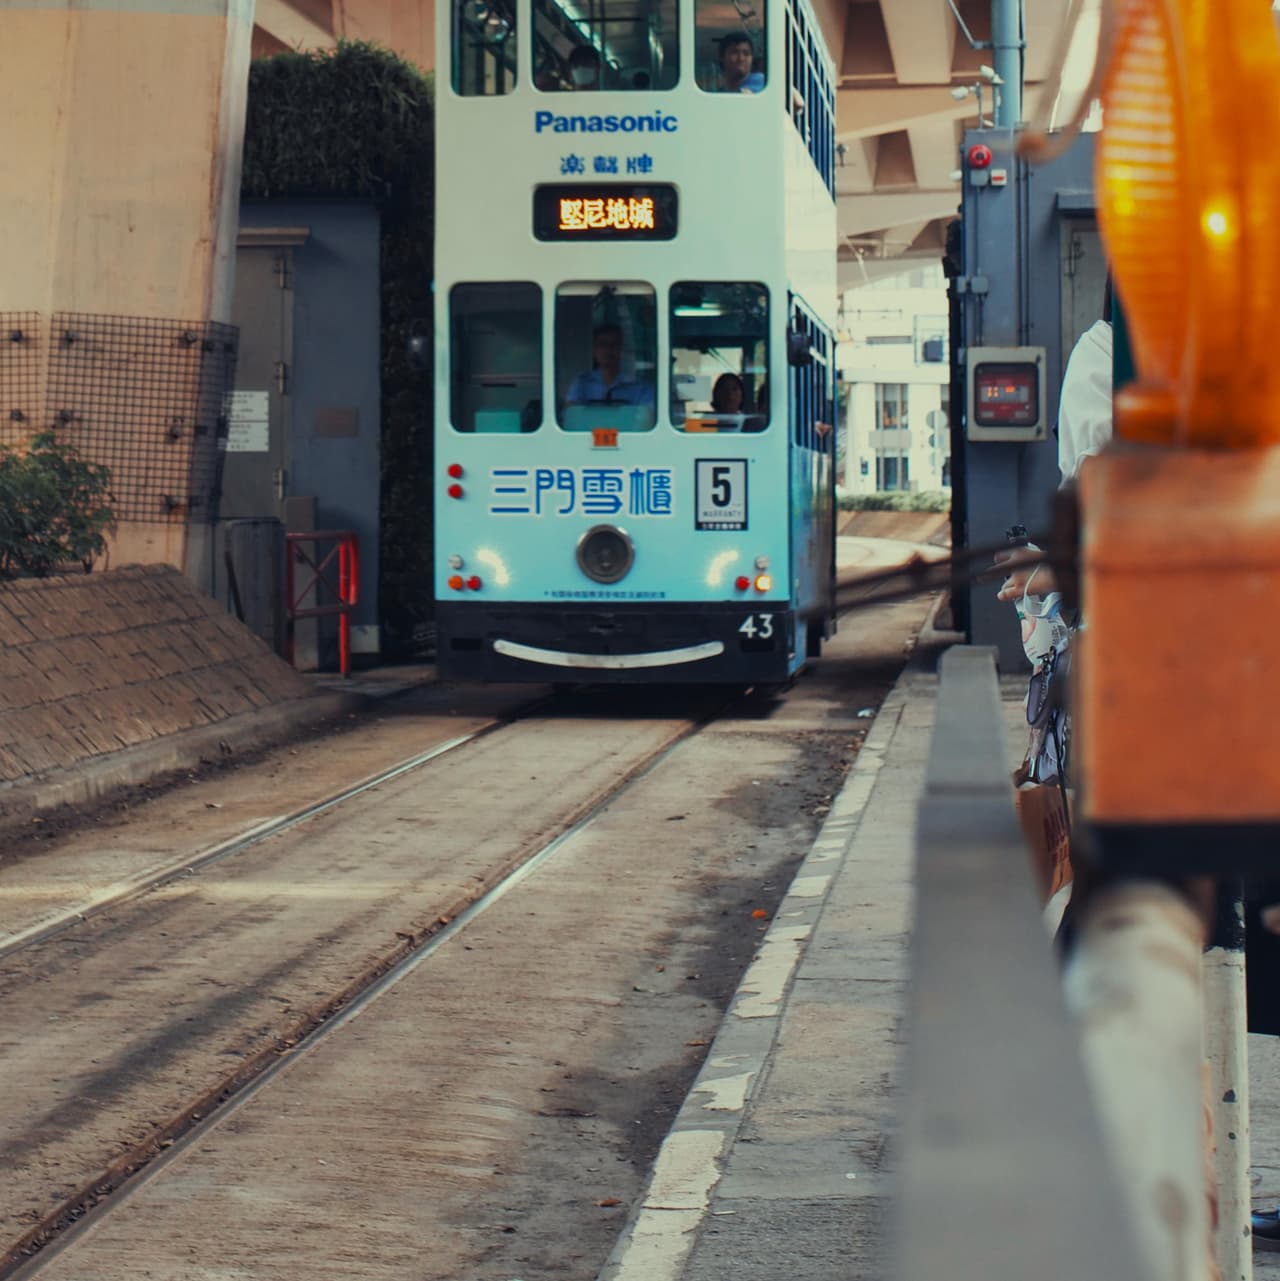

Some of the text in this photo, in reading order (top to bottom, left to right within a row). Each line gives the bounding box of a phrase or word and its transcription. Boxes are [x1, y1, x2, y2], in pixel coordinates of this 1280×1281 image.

[535, 110, 678, 133] Panasonic
[559, 198, 654, 230] 堅尼地城
[490, 468, 672, 515] 三門雪櫃
[711, 466, 731, 507] 5
[739, 614, 773, 638] 43
